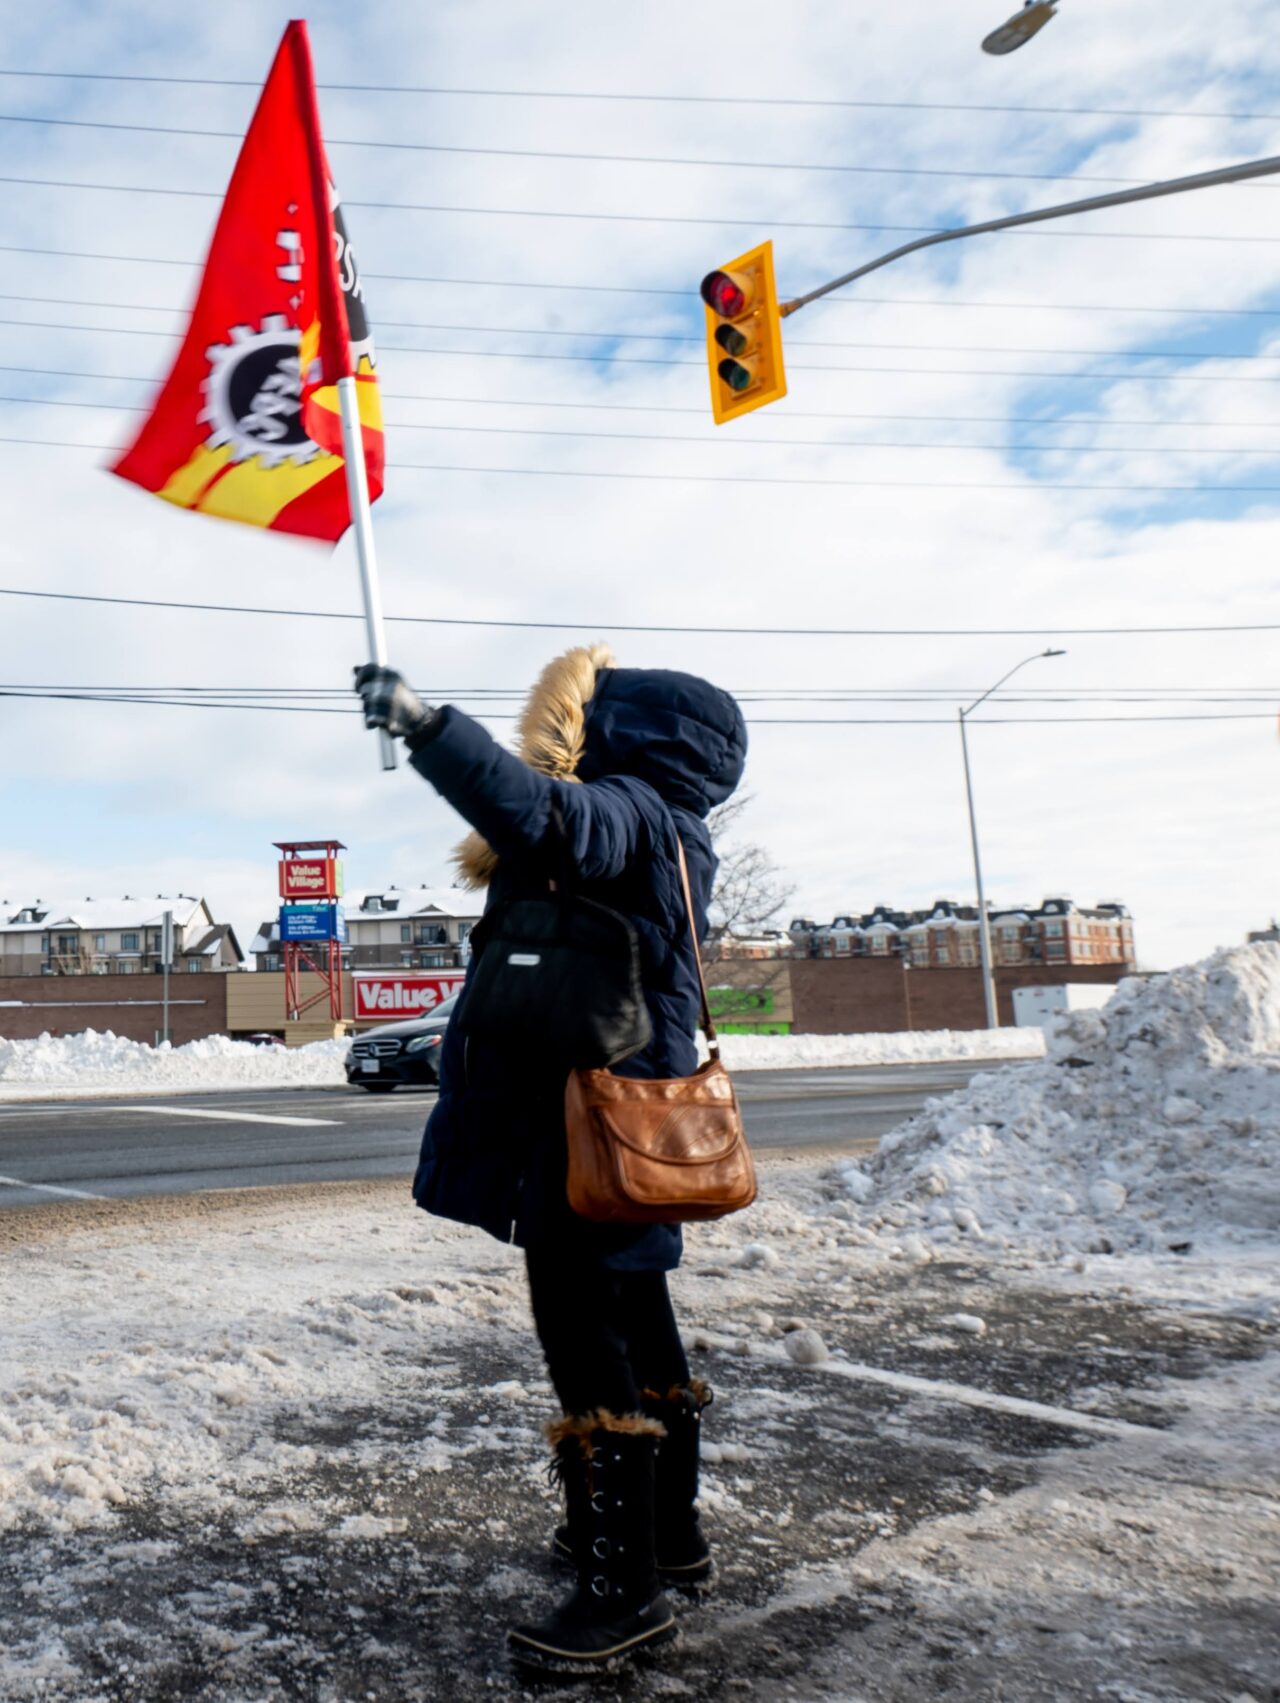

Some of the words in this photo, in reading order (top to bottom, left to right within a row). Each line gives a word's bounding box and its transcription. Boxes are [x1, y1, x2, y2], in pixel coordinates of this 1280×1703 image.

[290, 865, 321, 876] Value
[287, 876, 324, 888] Village
[359, 982, 438, 1009] Value
